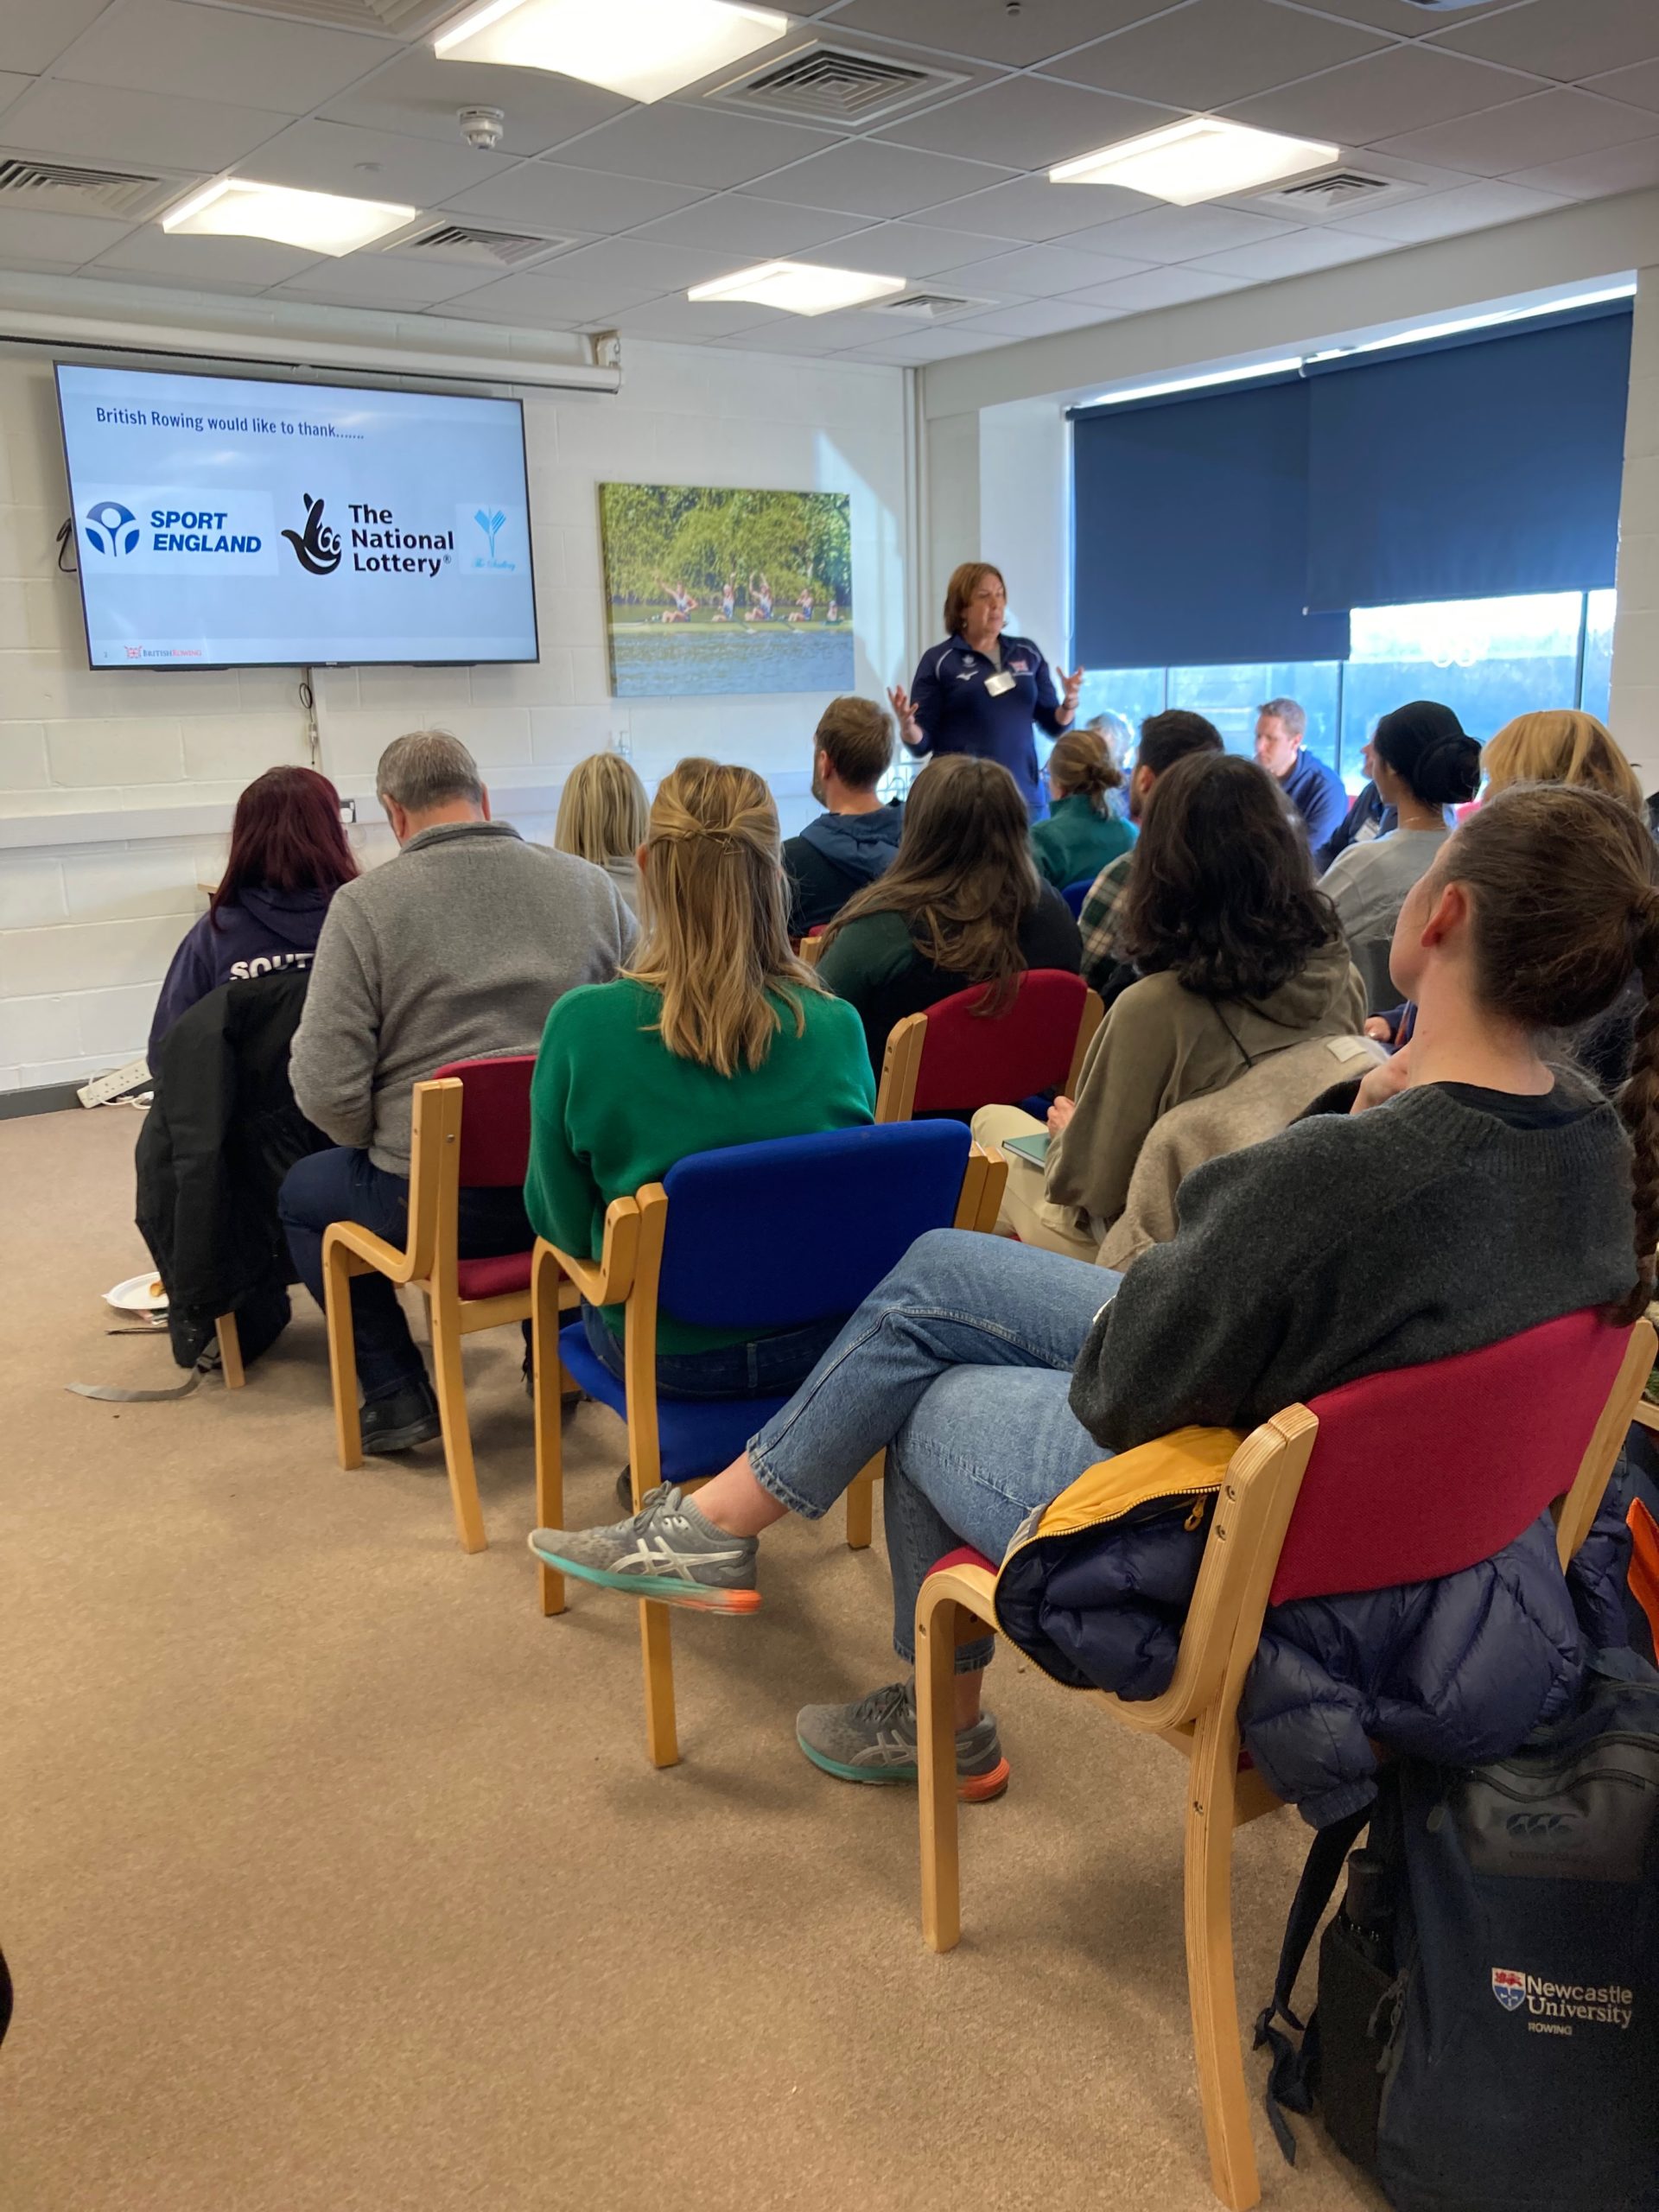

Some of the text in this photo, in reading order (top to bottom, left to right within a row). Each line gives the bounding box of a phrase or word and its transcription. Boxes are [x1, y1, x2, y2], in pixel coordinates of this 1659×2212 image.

[96, 407, 147, 425] British
[151, 411, 204, 432] Rowing
[207, 417, 248, 432] would
[252, 418, 276, 434] like
[281, 421, 295, 435] to
[149, 510, 228, 530] SPORT
[348, 504, 393, 524] The
[153, 533, 262, 553] ENGLAND
[351, 529, 454, 550] National
[1526, 1975, 1633, 2005] Newcastle
[1526, 1994, 1632, 2029] University
[1528, 2022, 1573, 2036] ROWING
